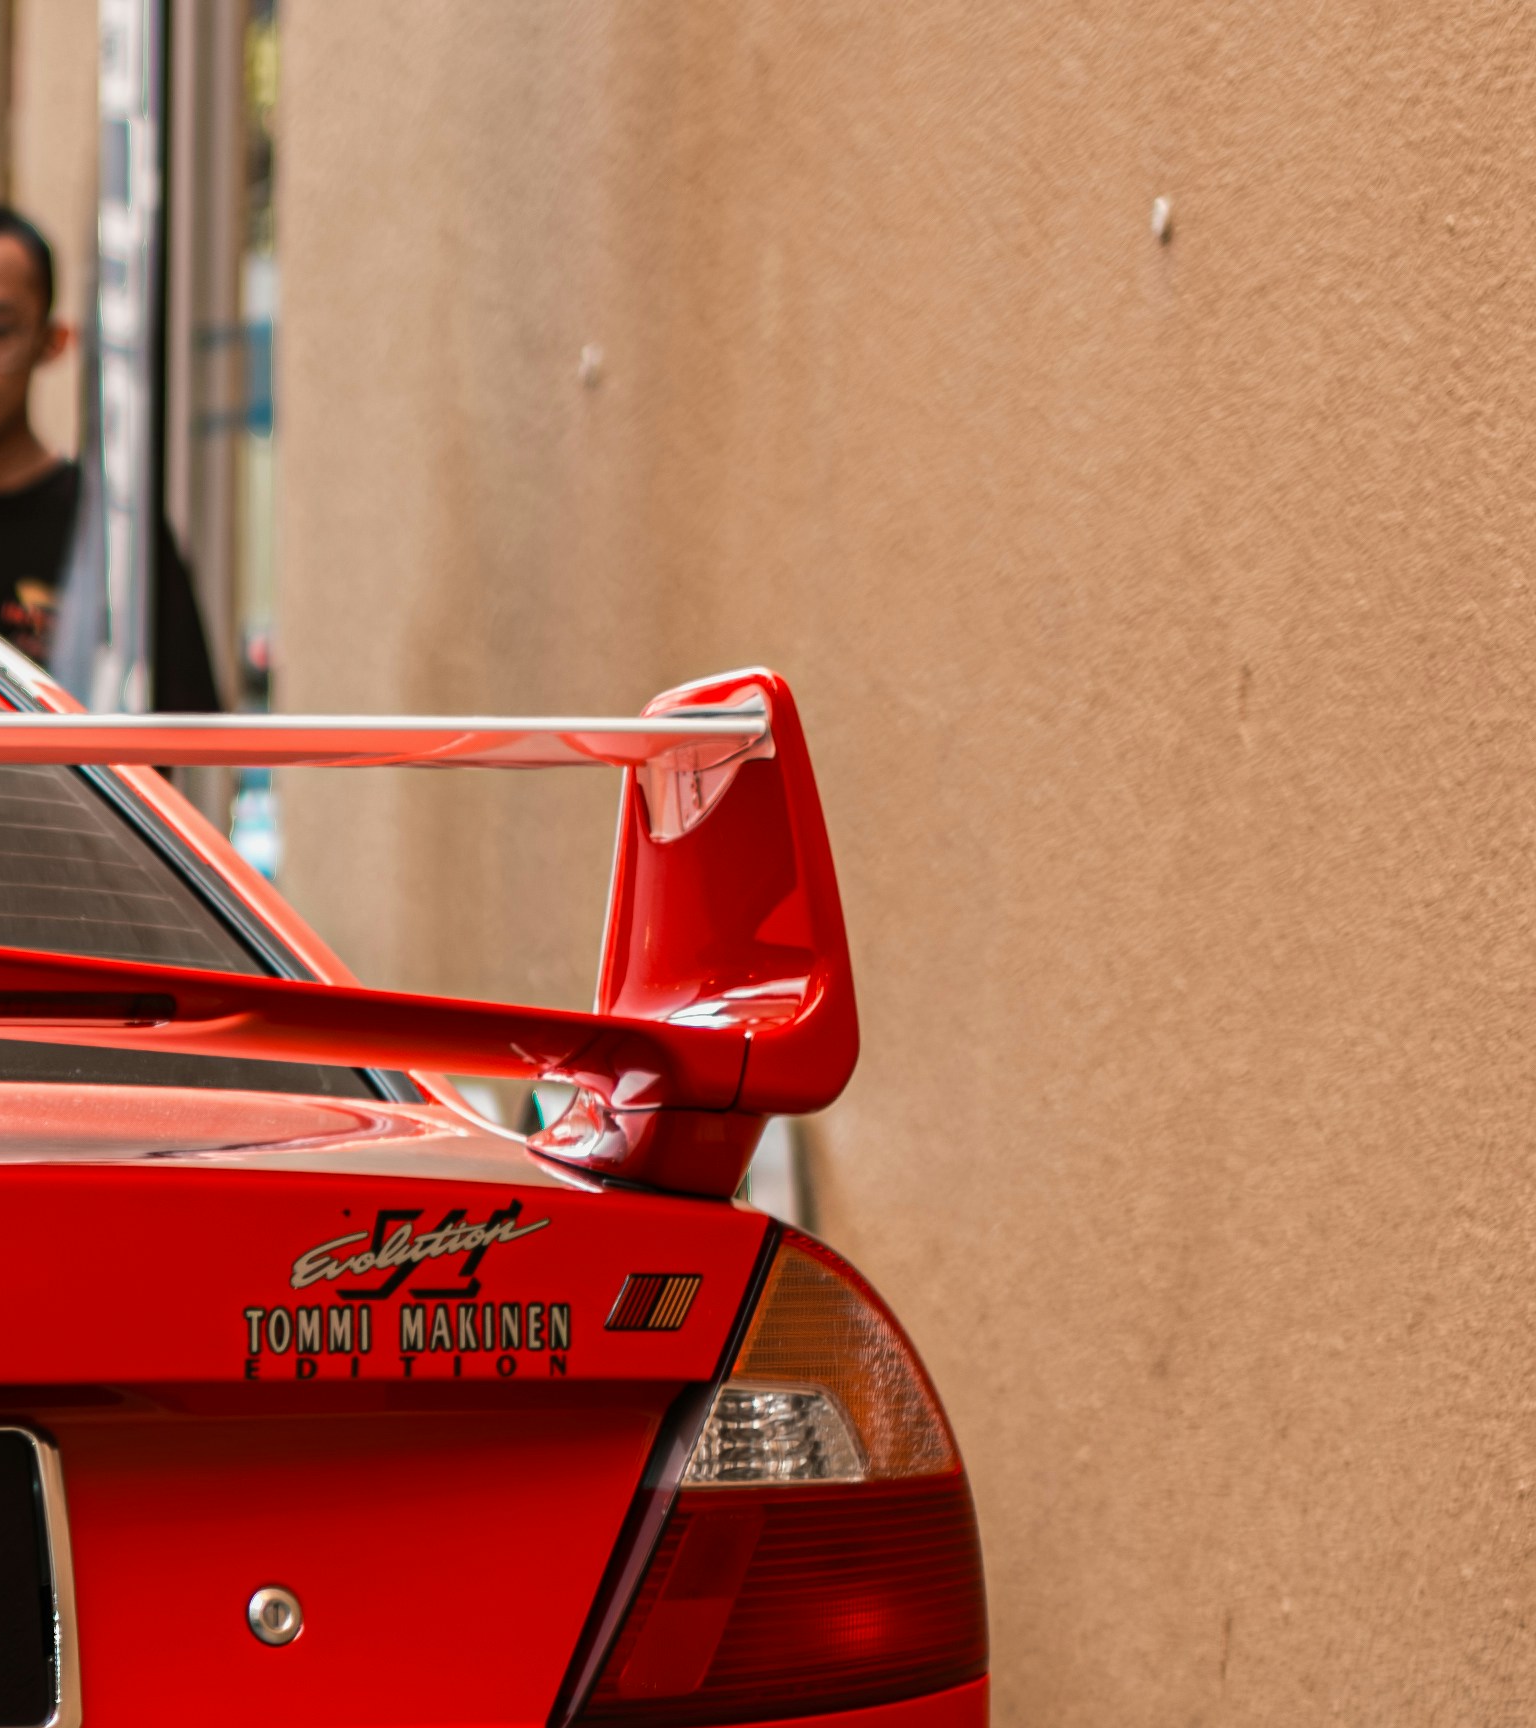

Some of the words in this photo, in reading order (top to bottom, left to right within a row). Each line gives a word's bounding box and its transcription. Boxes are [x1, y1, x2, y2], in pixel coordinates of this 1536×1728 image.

[289, 1217, 552, 1290] Evolution
[243, 1304, 372, 1355] TOMMI
[399, 1302, 571, 1353] MAKINEN
[243, 1354, 569, 1381] EDITION
